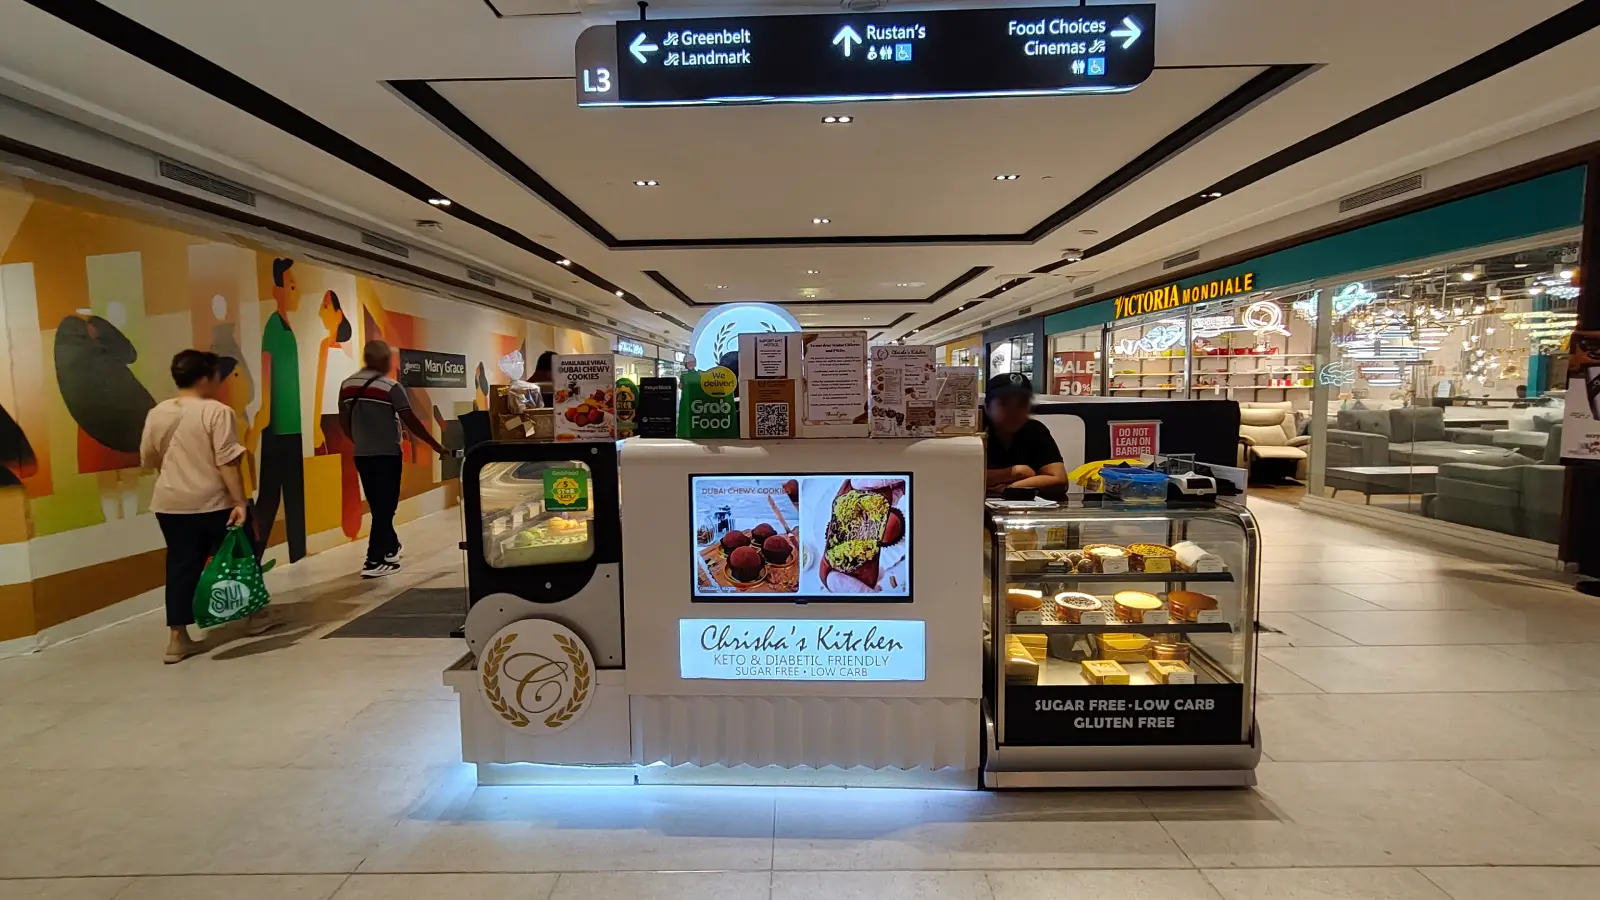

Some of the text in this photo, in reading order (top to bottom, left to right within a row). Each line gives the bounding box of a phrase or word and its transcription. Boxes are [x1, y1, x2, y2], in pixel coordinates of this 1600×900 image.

[866, 23, 926, 40] Rustan's
[1008, 18, 1106, 36] Food Choices
[681, 29, 751, 46] Greenbelt
[1024, 40, 1087, 55] Cinemas
[681, 49, 751, 66] Landmark
[583, 68, 611, 92] L3
[1114, 273, 1253, 319] VICTORIA MONDIALE
[424, 359, 444, 376] Mary
[444, 360, 464, 374] Grace
[1054, 360, 1096, 374] SALE
[567, 373, 600, 381] COOKIES
[704, 379, 734, 388] deliver!
[1059, 380, 1091, 396] 50%
[690, 399, 732, 414] Grab
[691, 416, 731, 430] Food
[1118, 427, 1149, 437] DO NOT
[1116, 436, 1151, 447] LEAN ON
[1116, 446, 1151, 456] BARRIER
[564, 480, 568, 488] 5
[700, 624, 904, 652] Chrisha's Kitchen
[714, 654, 889, 667] KETO & DIABETIC FRIENDLY
[736, 666, 868, 677] SUGAR FREE LOW CARB
[1034, 698, 1215, 711] SUGAR FREE LOW CARB
[1074, 716, 1175, 729] GLUTEN FREE
